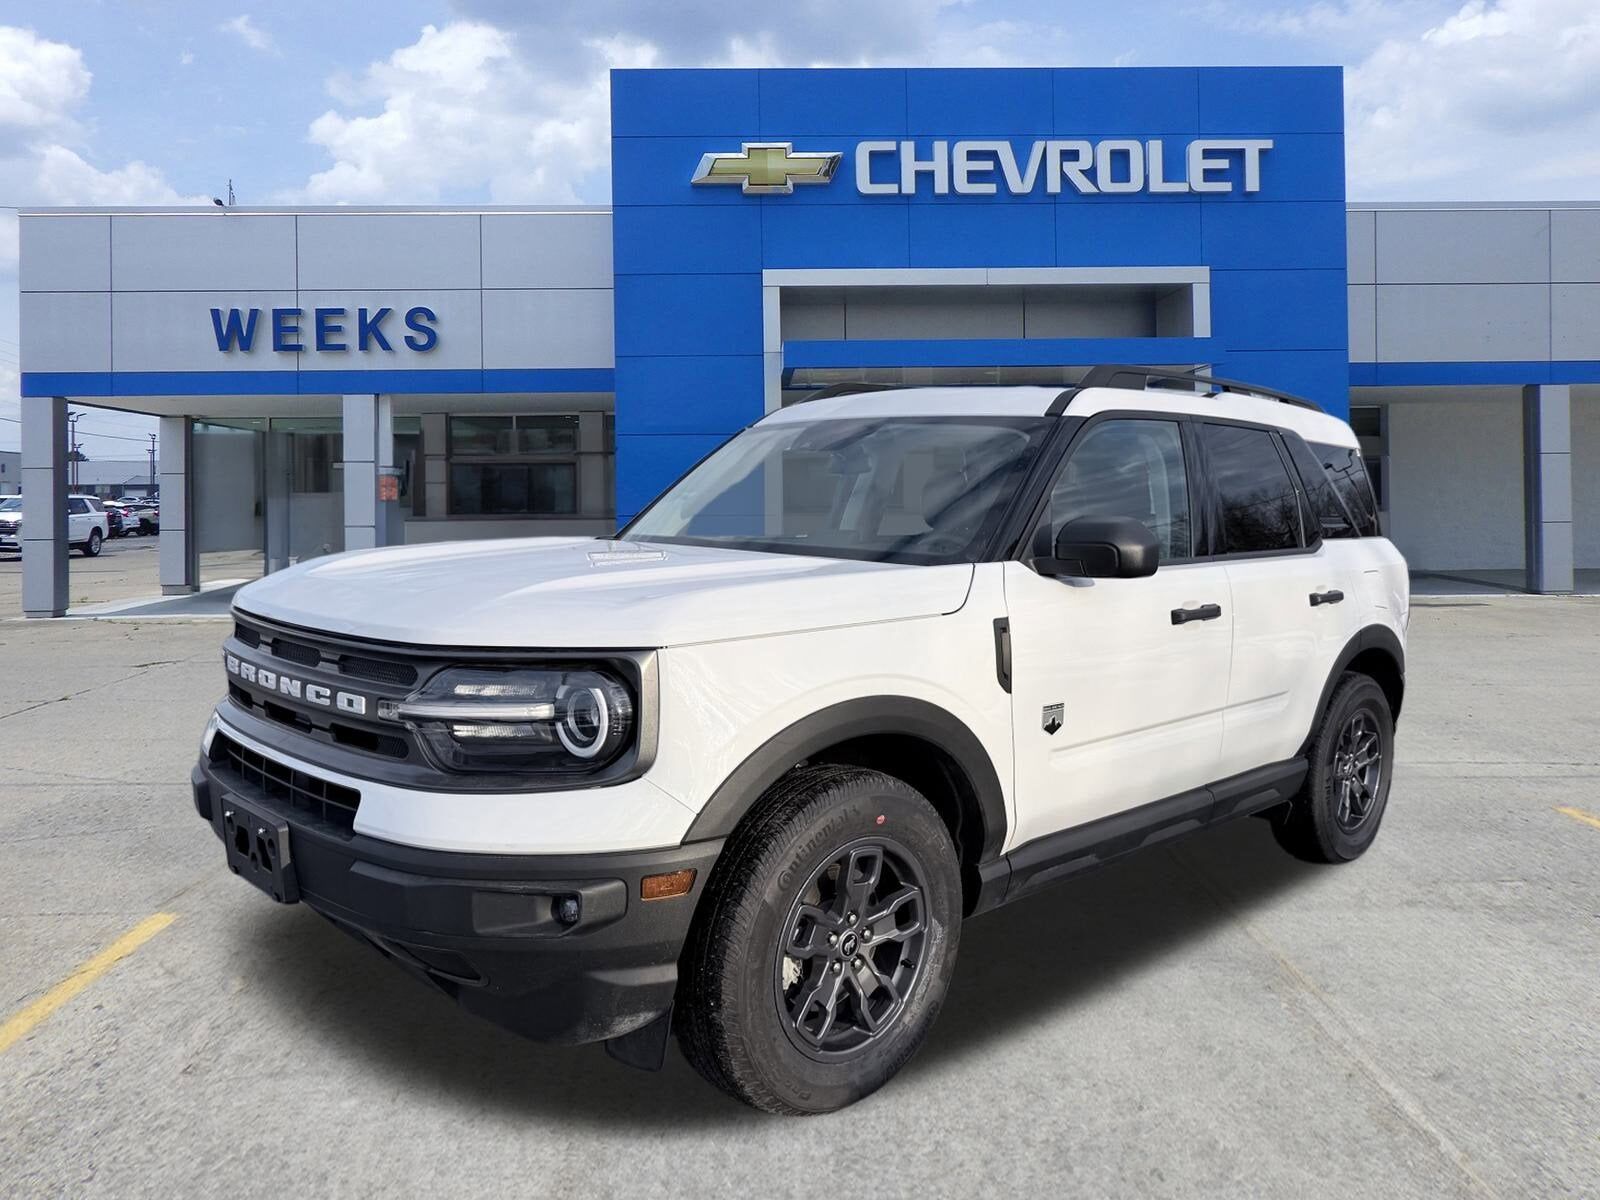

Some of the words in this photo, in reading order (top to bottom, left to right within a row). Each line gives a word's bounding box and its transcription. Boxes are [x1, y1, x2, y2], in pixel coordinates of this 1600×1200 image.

[855, 139, 1274, 194] CHEVROLET
[210, 306, 438, 352] WEEKS
[226, 655, 367, 715] BRONCO
